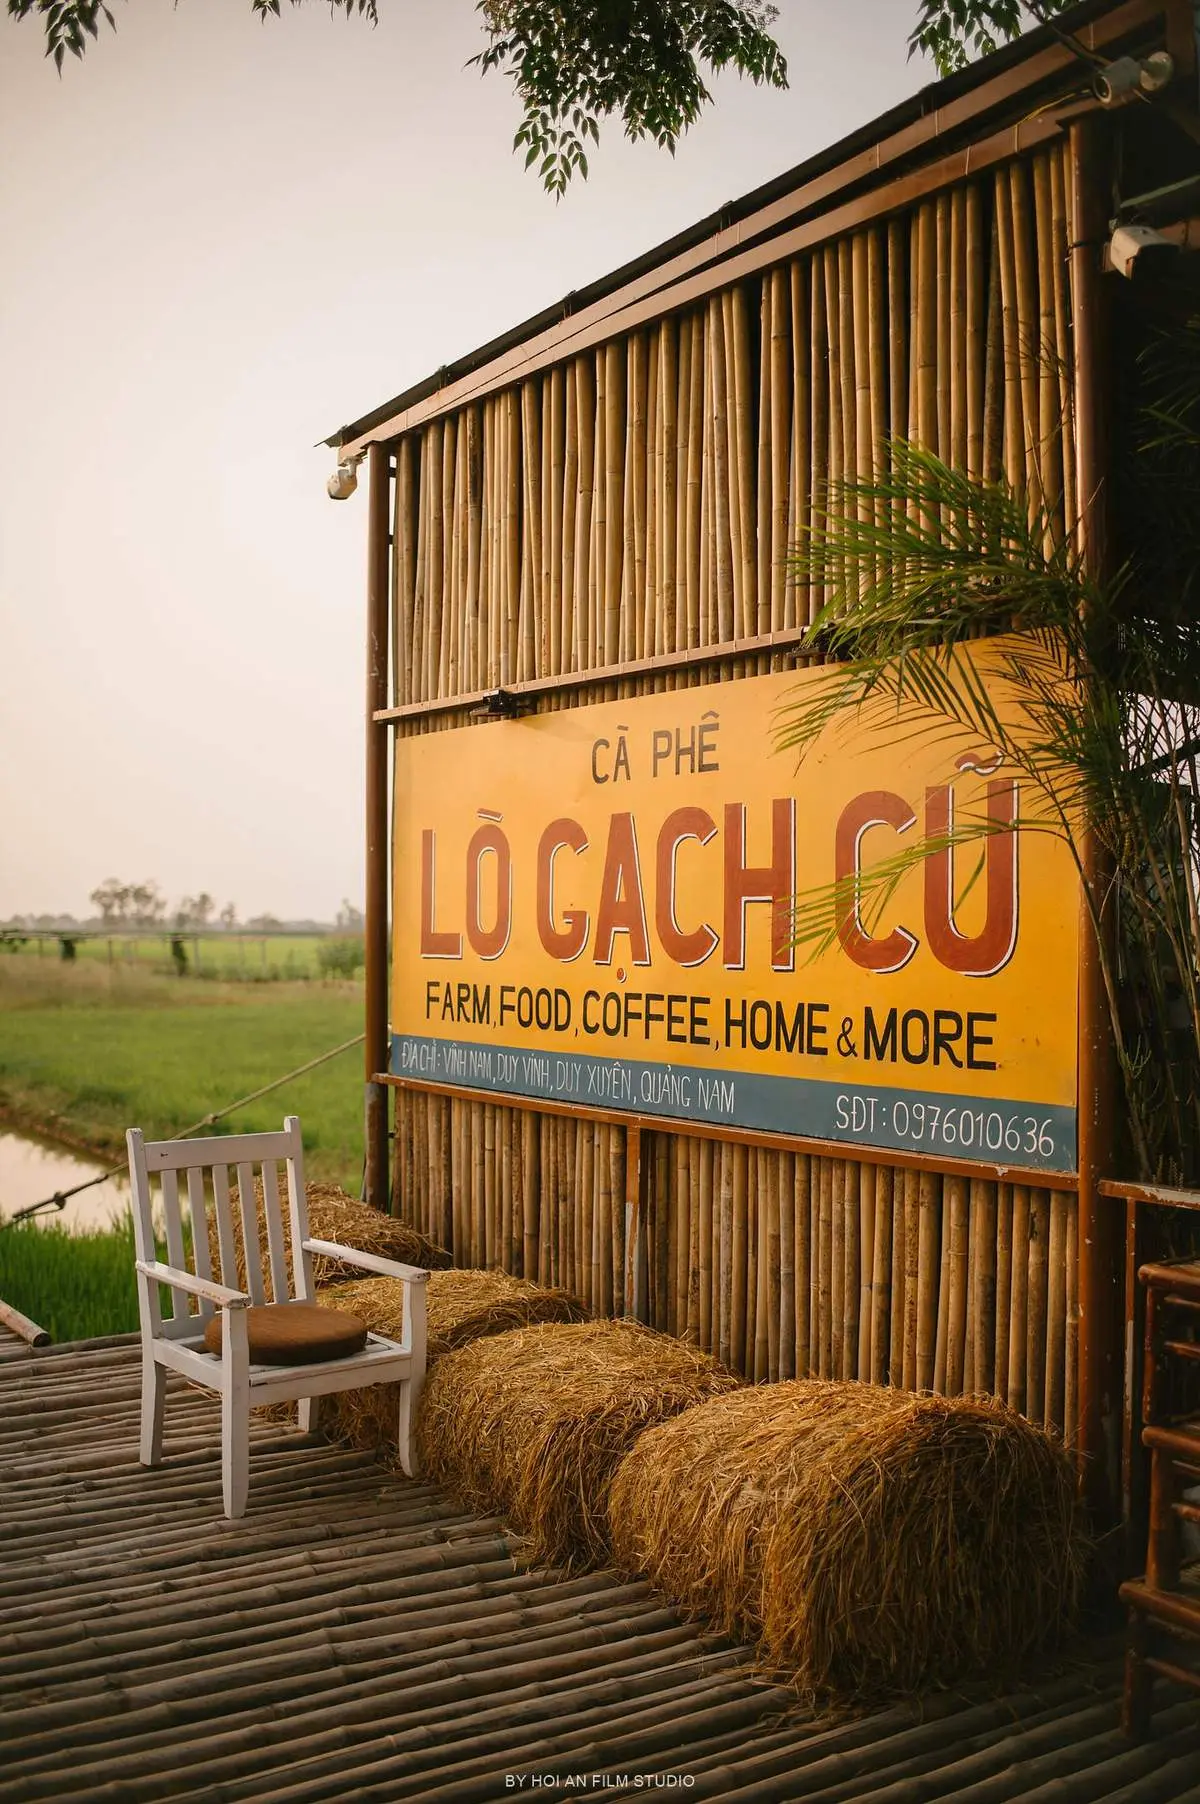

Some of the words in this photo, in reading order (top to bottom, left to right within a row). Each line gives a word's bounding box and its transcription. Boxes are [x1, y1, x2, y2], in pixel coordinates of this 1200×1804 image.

[592, 725, 631, 784] CÀ
[653, 710, 720, 778] PHÊ
[421, 808, 512, 960] LÒ
[537, 797, 796, 983] GẠCH
[835, 750, 1020, 978] CŨ
[725, 998, 829, 1056] HOME
[836, 1016, 858, 1057] &
[863, 1006, 997, 1070] MORE
[497, 1053, 519, 1083] DUY
[556, 1061, 582, 1093] DUY
[640, 1064, 692, 1107] QUẢNG
[698, 1077, 735, 1114] NAM
[893, 1101, 1055, 1157] 0976010636
